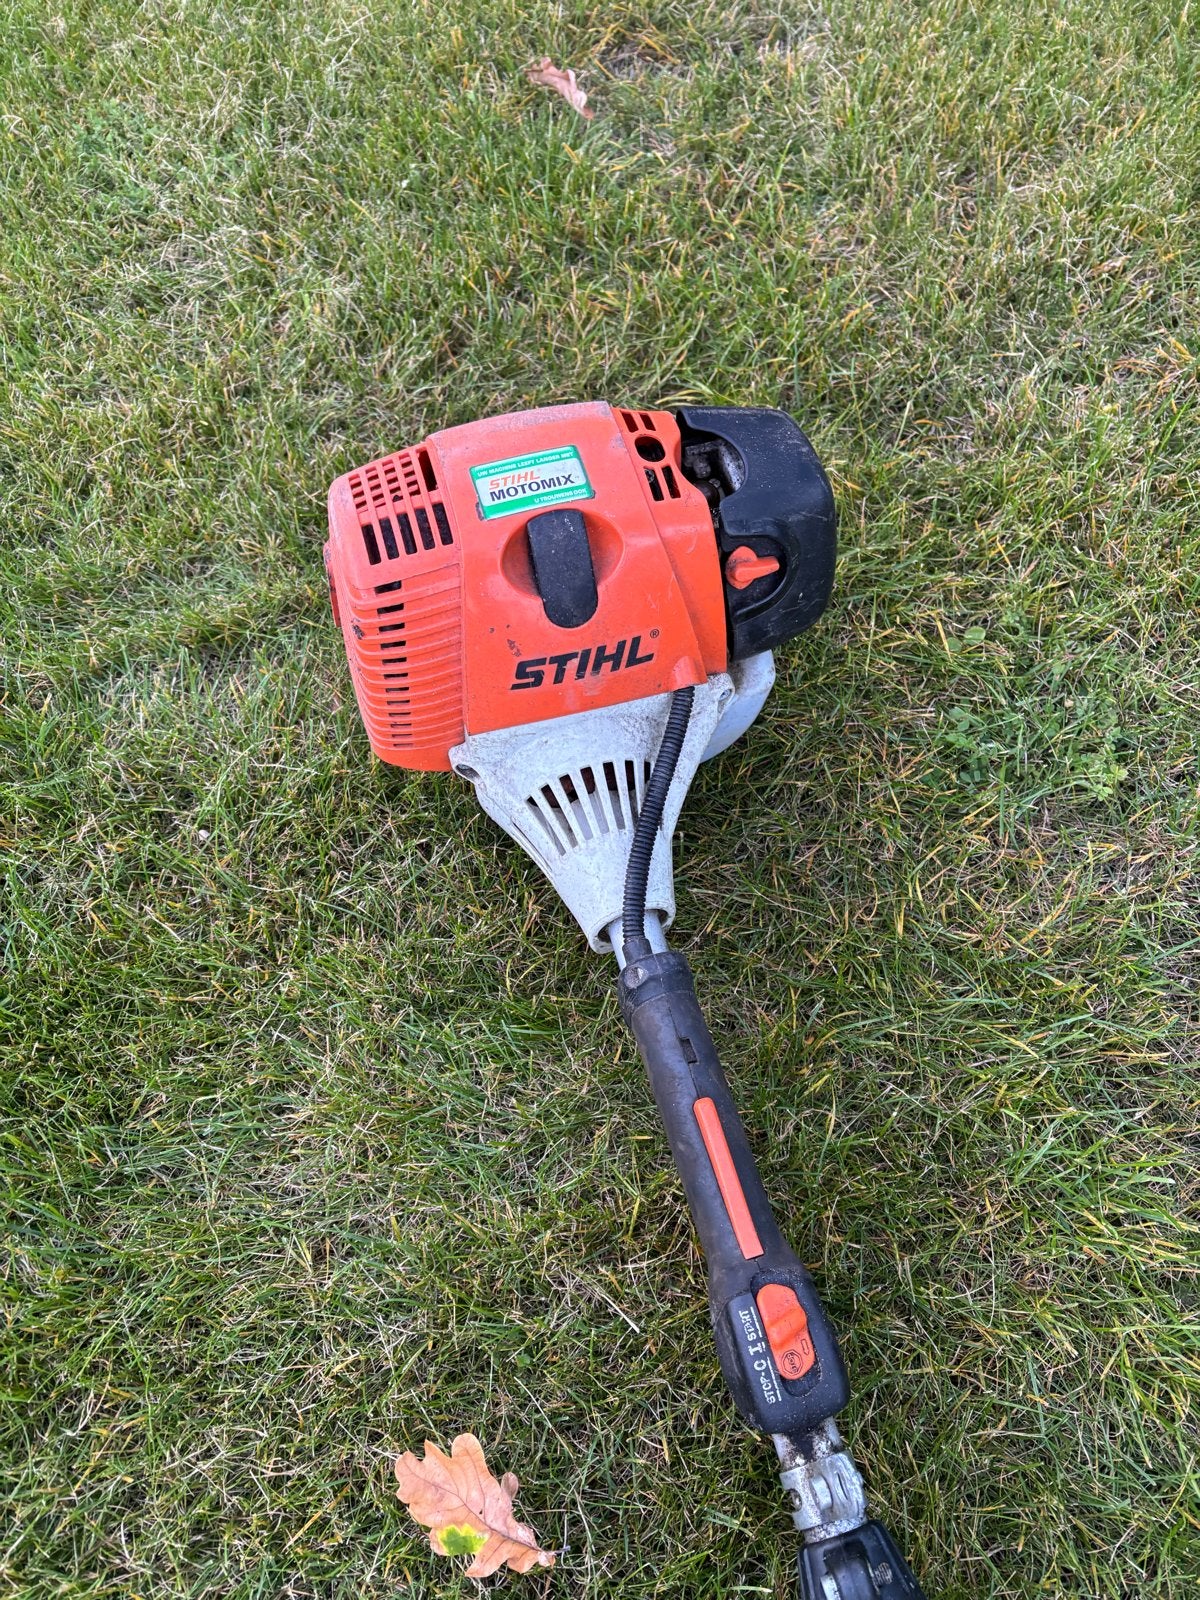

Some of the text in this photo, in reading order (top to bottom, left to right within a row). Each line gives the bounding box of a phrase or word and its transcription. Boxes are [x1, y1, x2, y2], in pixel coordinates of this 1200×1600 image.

[488, 463, 516, 475] MACHINE
[489, 470, 541, 490] STIHL
[489, 474, 575, 502] MOTOMIX
[510, 635, 654, 690] STIHL
[738, 1310, 757, 1341] START
